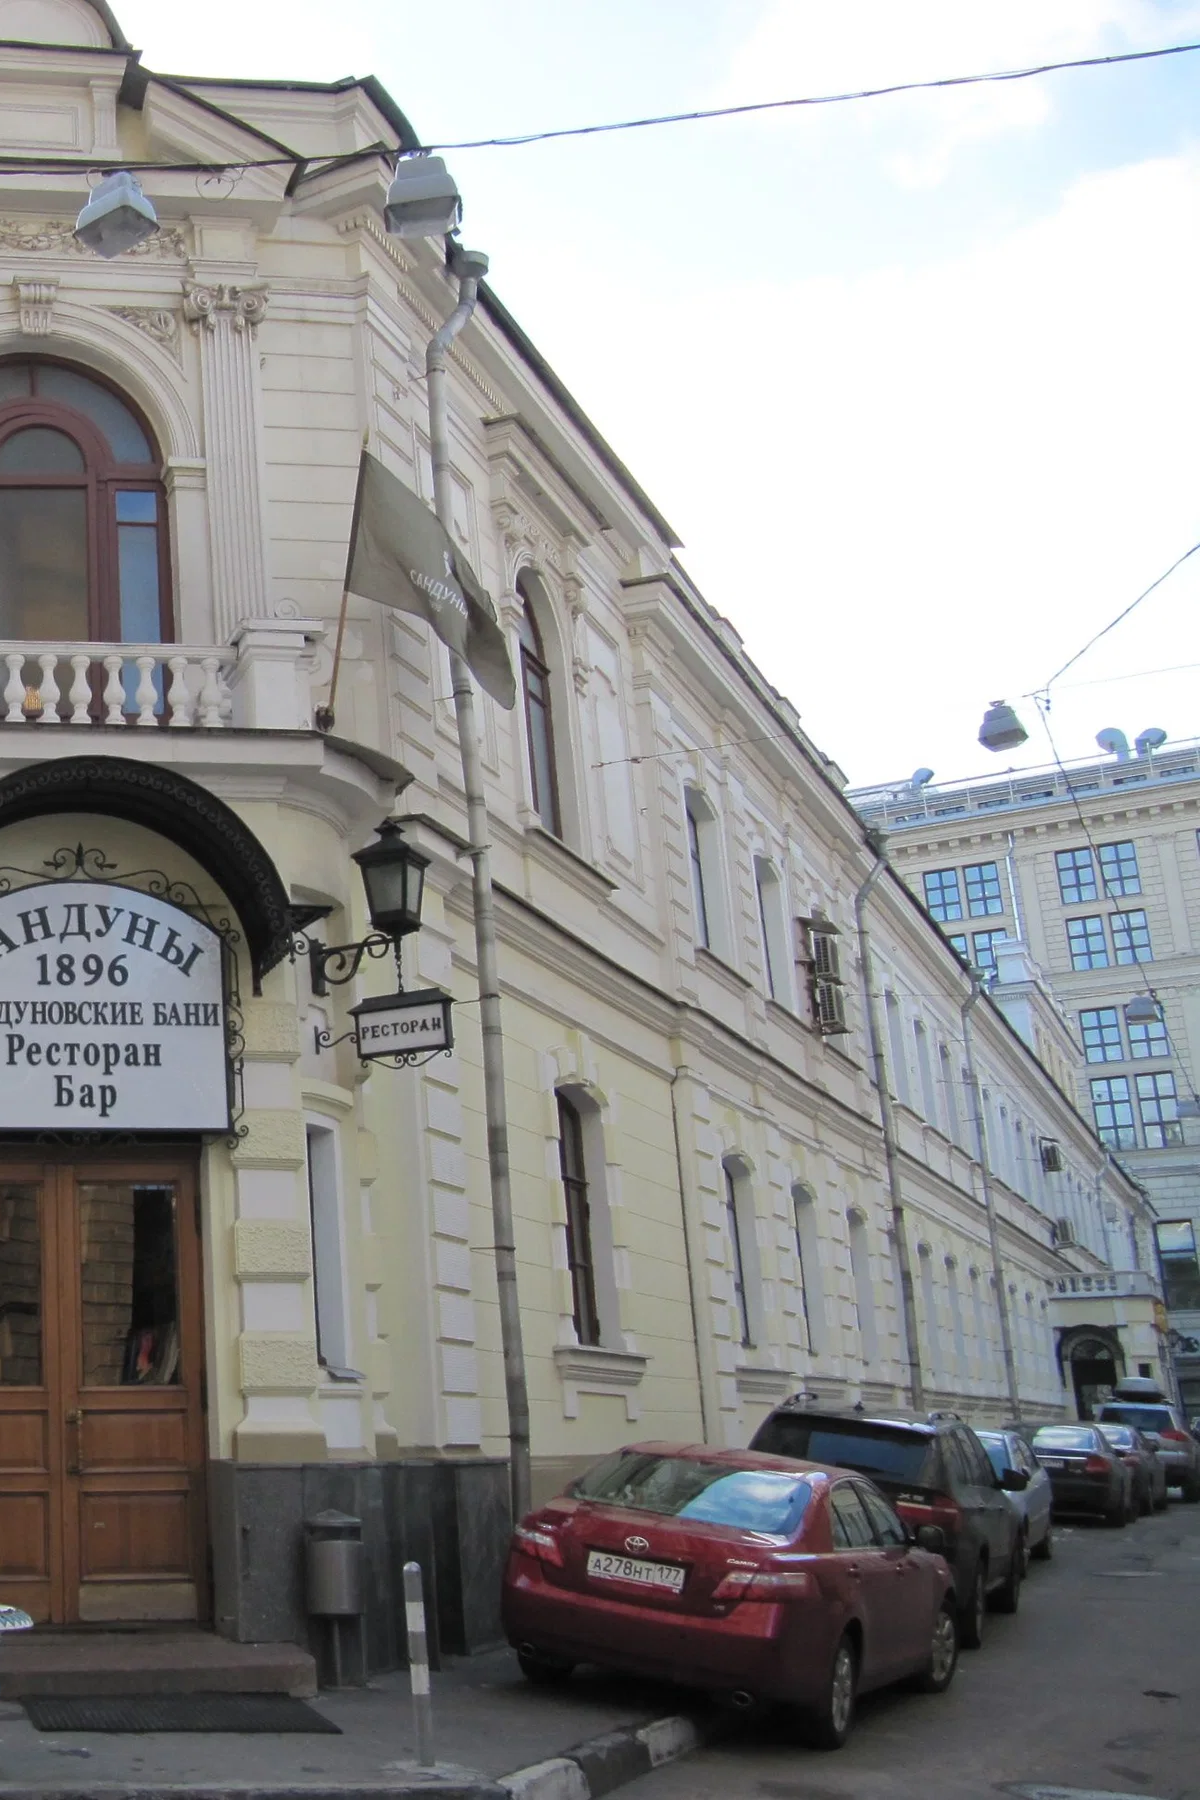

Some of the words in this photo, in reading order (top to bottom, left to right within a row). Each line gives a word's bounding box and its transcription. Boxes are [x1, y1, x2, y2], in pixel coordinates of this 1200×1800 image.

[36, 953, 129, 986] 1896
[152, 1002, 220, 1026] БАНИ
[361, 1017, 442, 1040] РЕСТОРАН
[5, 1033, 162, 1075] Ресторан
[54, 1075, 118, 1117] Бар
